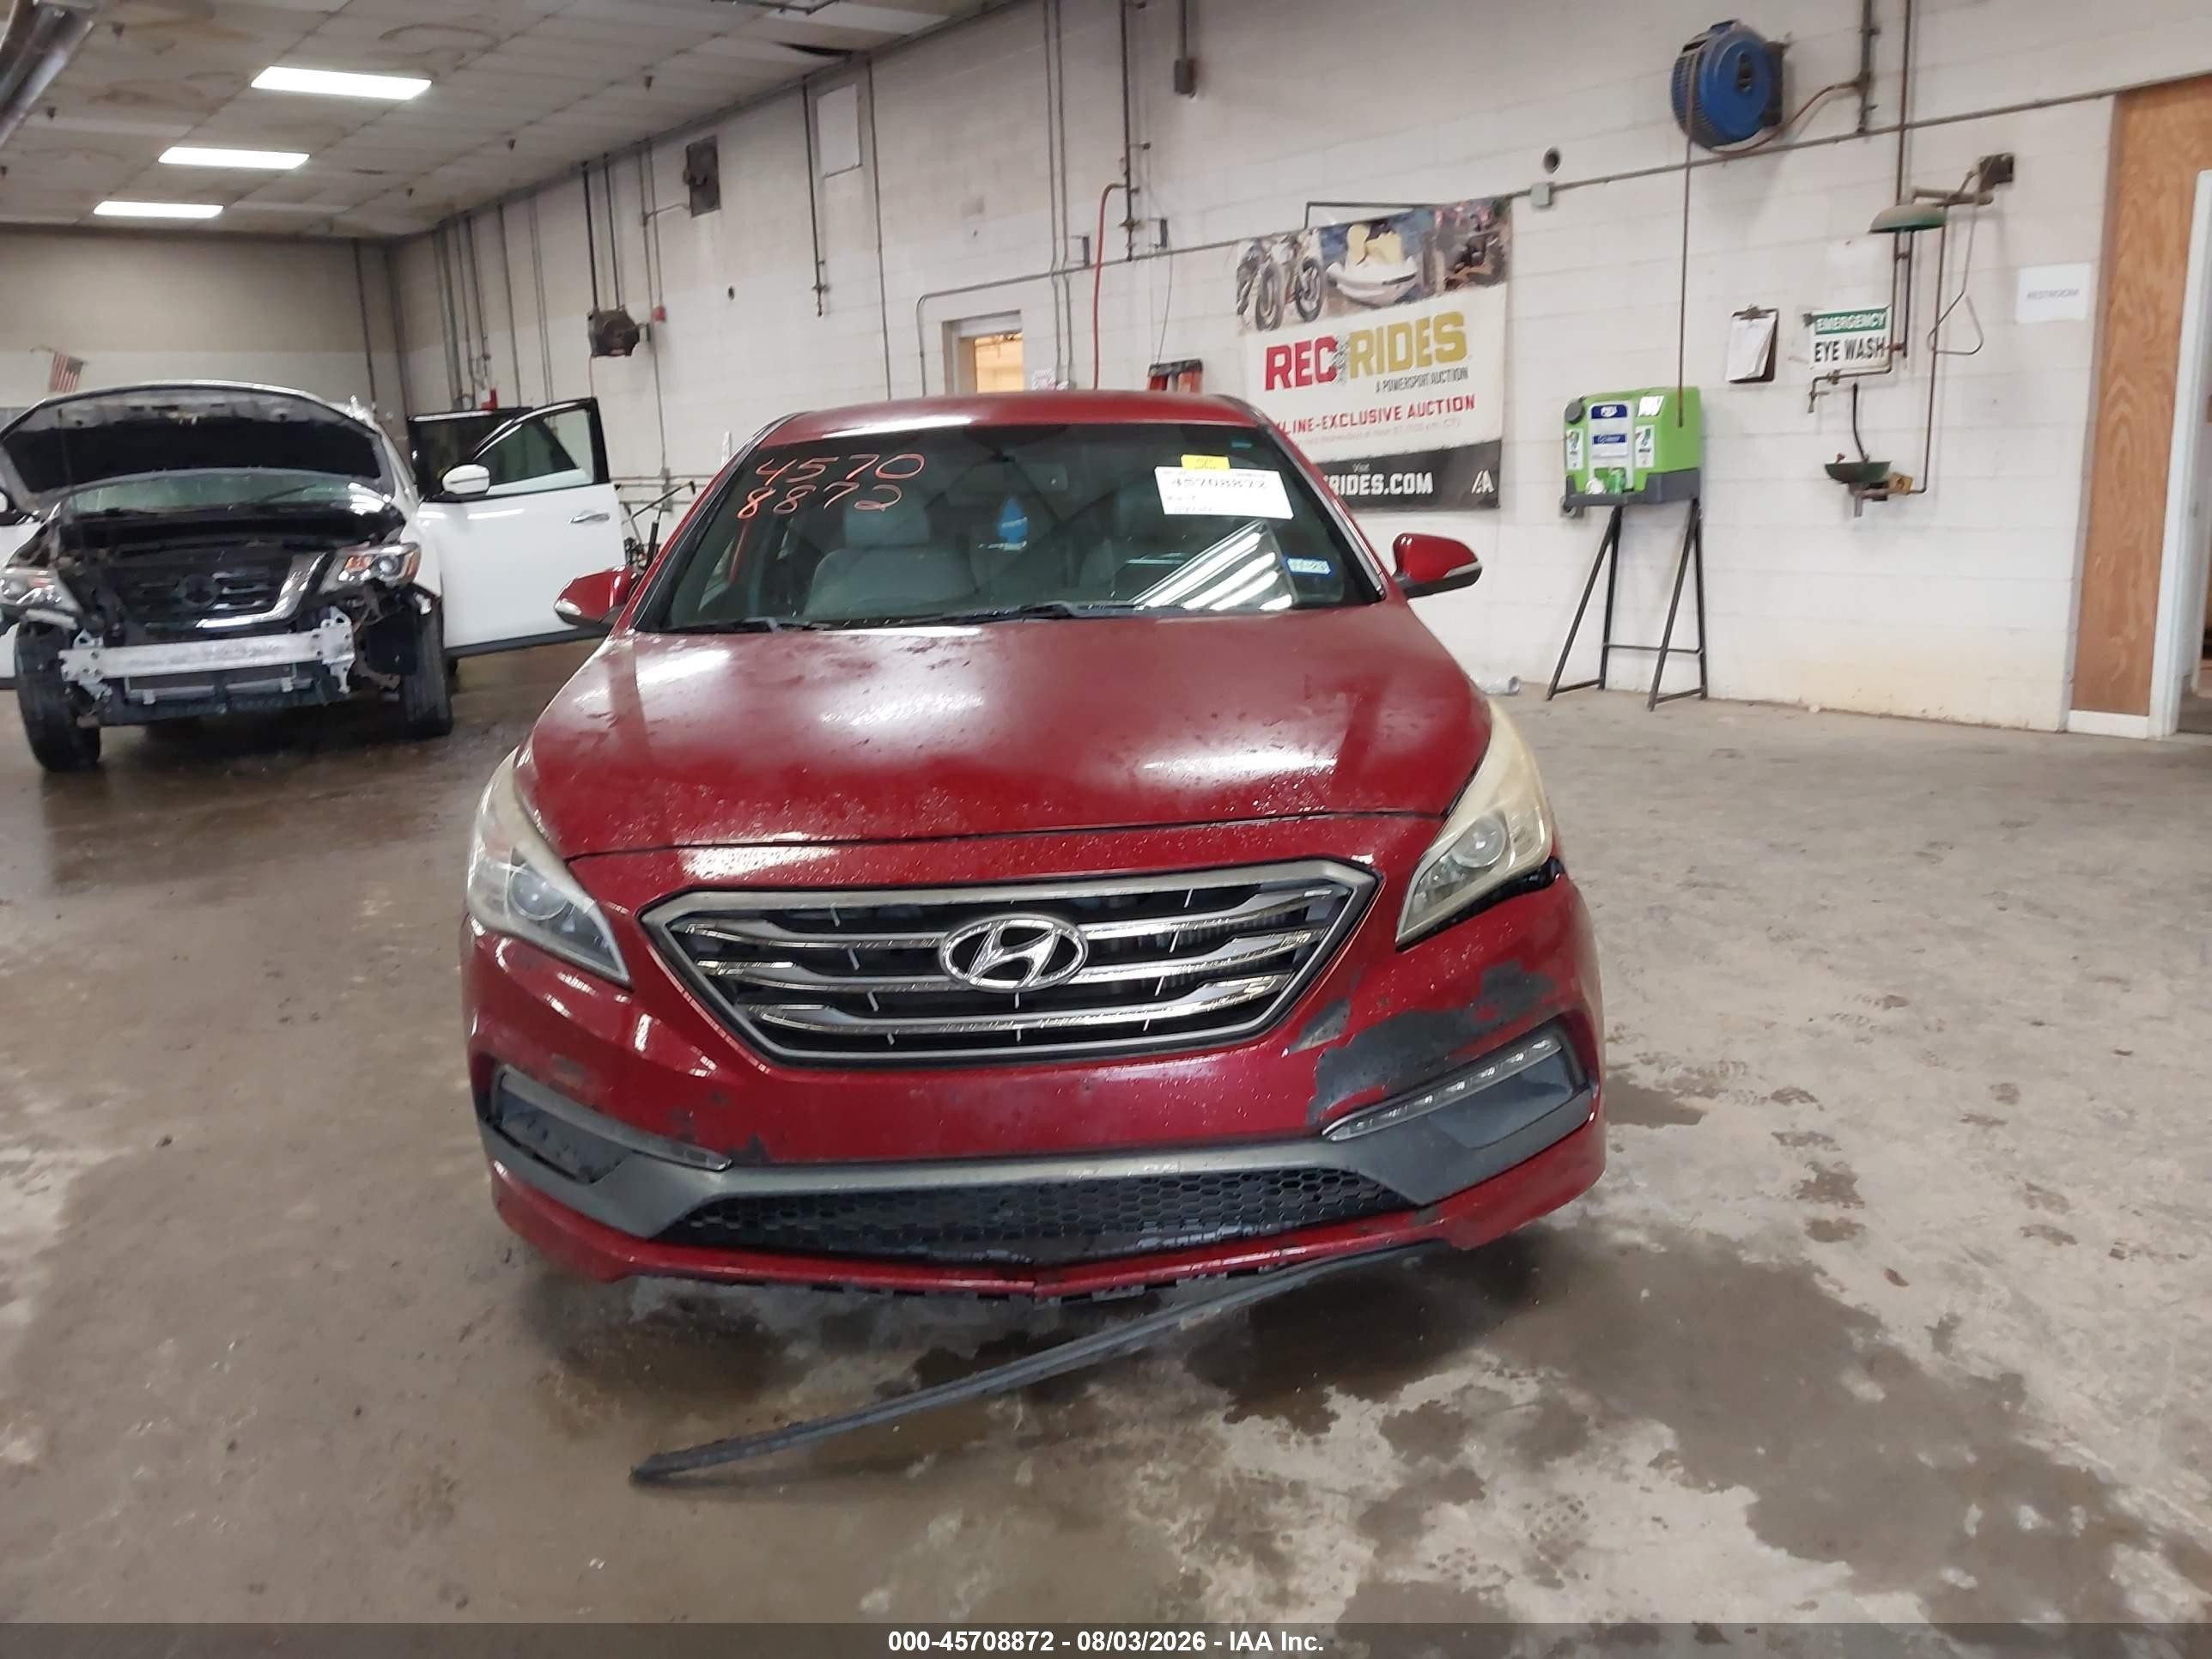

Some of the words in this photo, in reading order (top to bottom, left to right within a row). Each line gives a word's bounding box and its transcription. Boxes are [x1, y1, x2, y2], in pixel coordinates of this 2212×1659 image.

[1816, 313, 1887, 331] EMERGENCY
[1265, 335, 1339, 391] REC
[1347, 311, 1468, 379] RIDES
[1814, 341, 1839, 362] EYE
[1844, 337, 1886, 360] WASH
[1431, 367, 1469, 386] AUCTION
[1407, 394, 1475, 419] AUCTION
[756, 453, 925, 486] 4570
[737, 481, 902, 520] 8872
